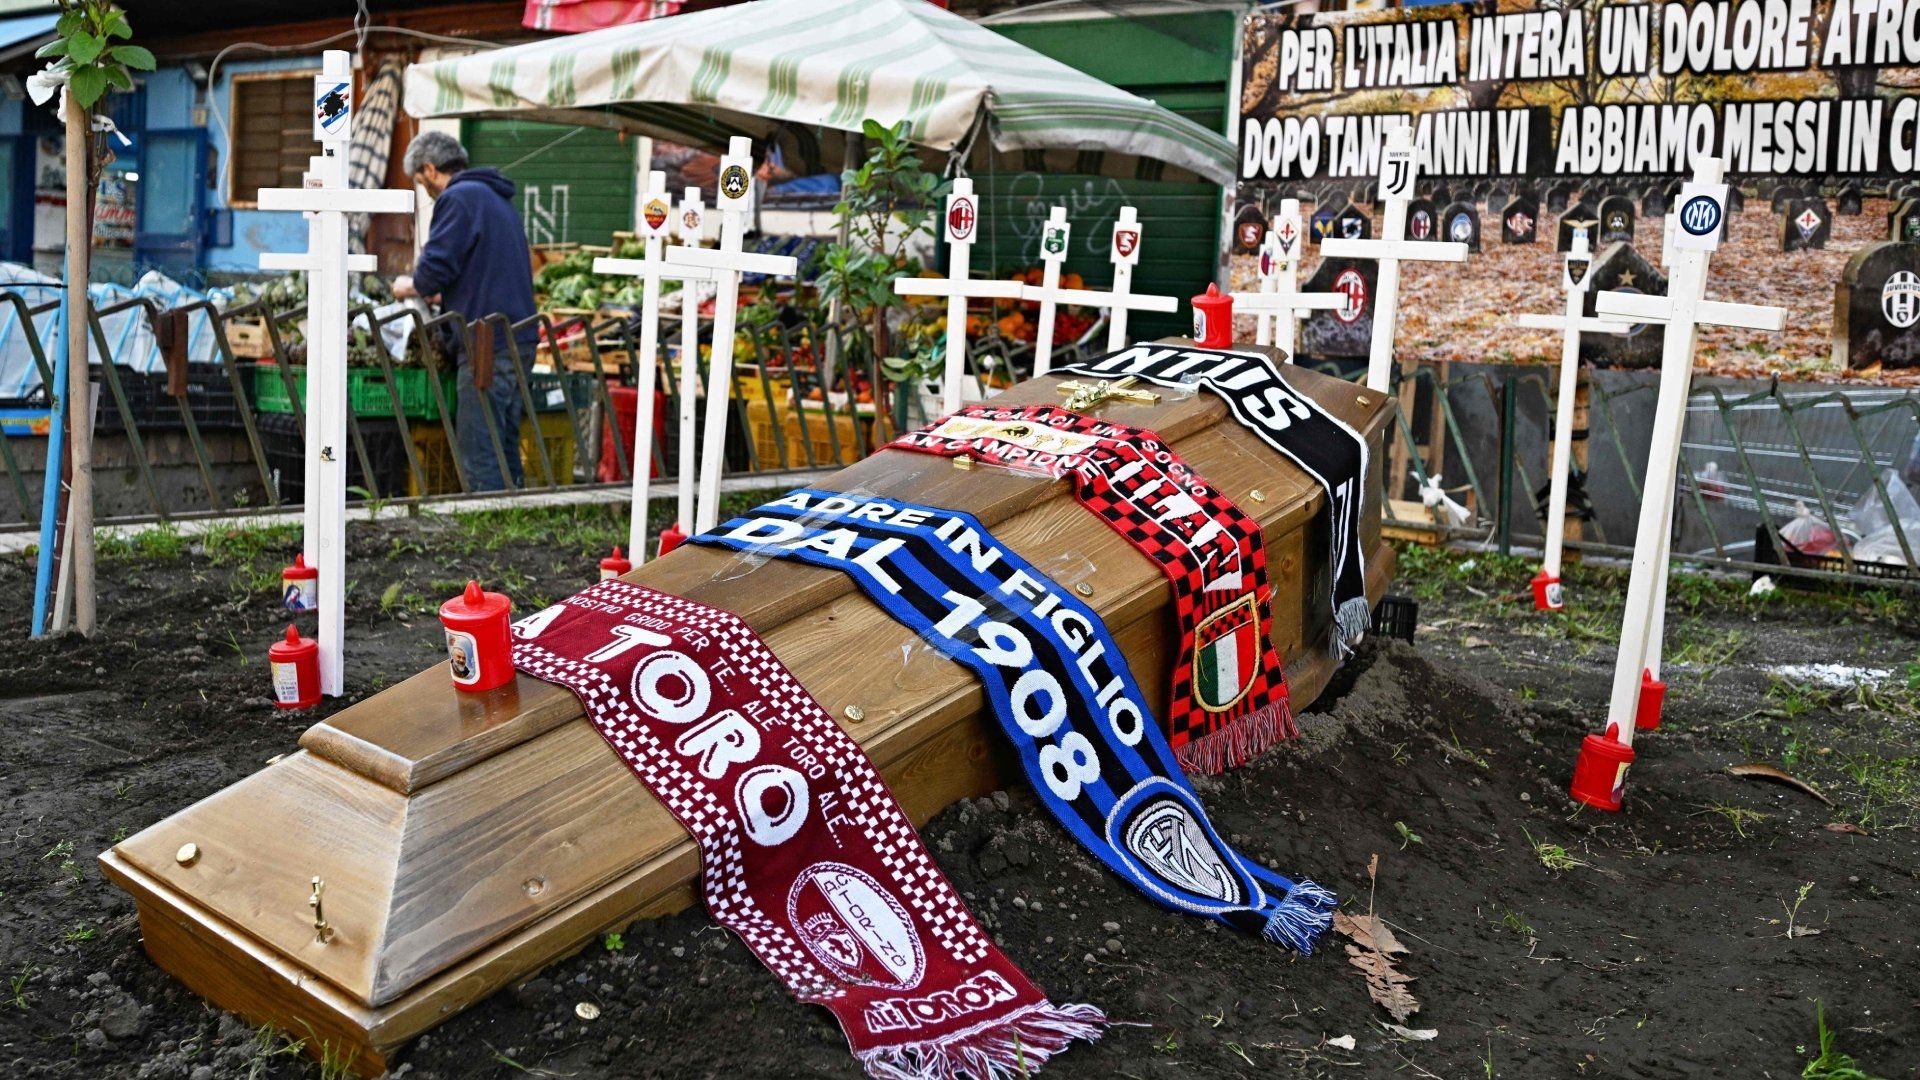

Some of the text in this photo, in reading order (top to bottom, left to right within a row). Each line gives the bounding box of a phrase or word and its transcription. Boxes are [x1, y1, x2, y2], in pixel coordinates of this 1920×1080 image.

[1279, 28, 1334, 91] PER
[1344, 20, 1457, 88] L'ITALIA
[1469, 9, 1585, 82] INTERA
[1600, 5, 1649, 76] UN
[1663, 0, 1811, 74] DOLORE
[1243, 97, 1920, 179] DOPO TAN ANNI VI ABBIAMO MESSI IN C
[1067, 347, 1311, 431] NTUS
[945, 436, 1102, 487] CAMPIONE
[1090, 424, 1126, 437] UN
[1141, 439, 1208, 497] SOGNO
[1085, 438, 1241, 586] MILAN
[722, 516, 1102, 802] DAL 1908
[765, 491, 1145, 747] ADRE IN FIGLIO
[583, 624, 810, 847] TORO
[624, 612, 673, 632] GRIDO
[673, 626, 710, 653] PER
[782, 736, 826, 780] TORO
[839, 890, 907, 967] TORINO
